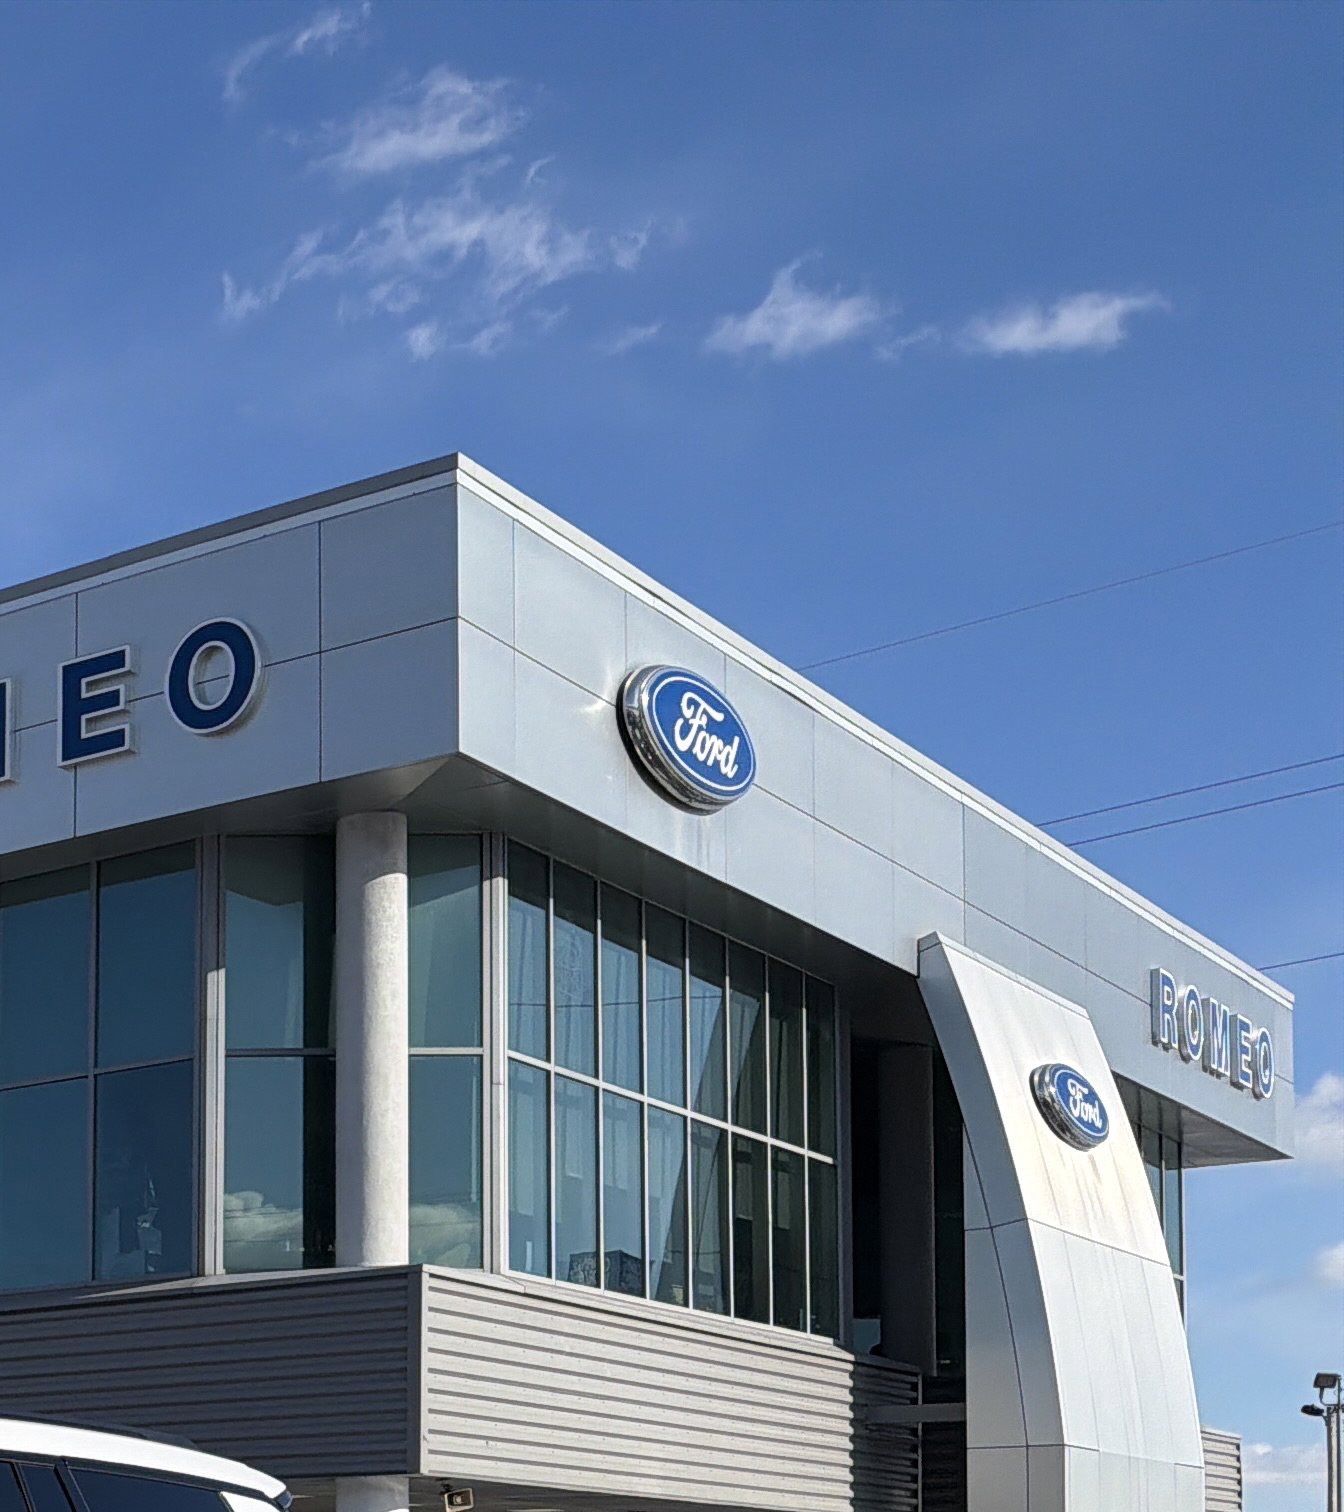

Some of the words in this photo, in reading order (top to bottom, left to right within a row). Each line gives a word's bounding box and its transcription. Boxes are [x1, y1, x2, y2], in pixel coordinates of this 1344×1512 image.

[674, 691, 740, 779] Ford
[1151, 967, 1275, 1099] ROMEO
[1067, 1079, 1103, 1129] Ford
